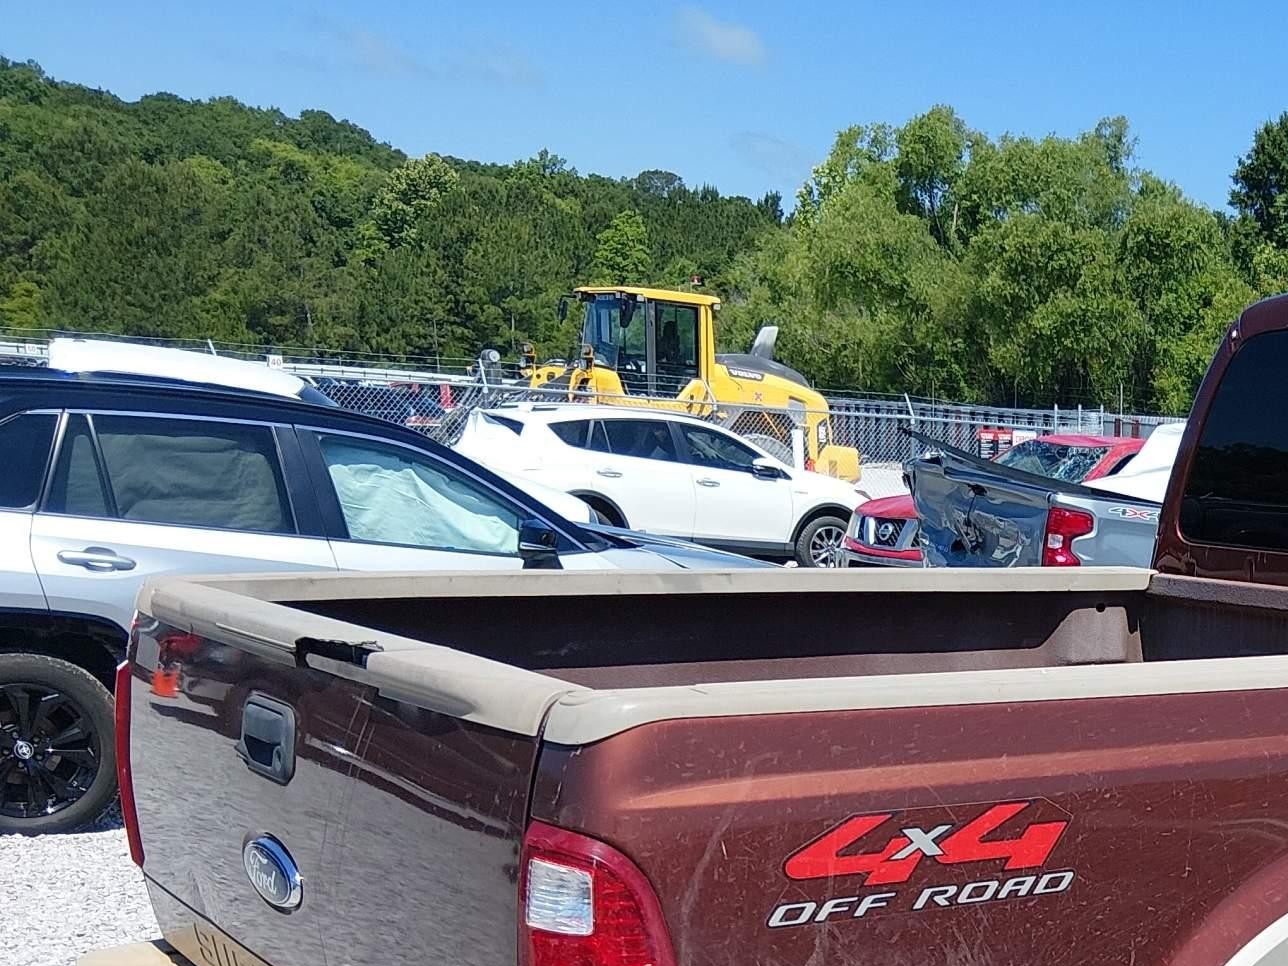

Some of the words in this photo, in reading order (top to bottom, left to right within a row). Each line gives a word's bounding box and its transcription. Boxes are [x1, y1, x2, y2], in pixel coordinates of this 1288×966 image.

[249, 850, 277, 895] Ford
[768, 892, 897, 928] OFF
[911, 871, 1075, 910] ROAD
